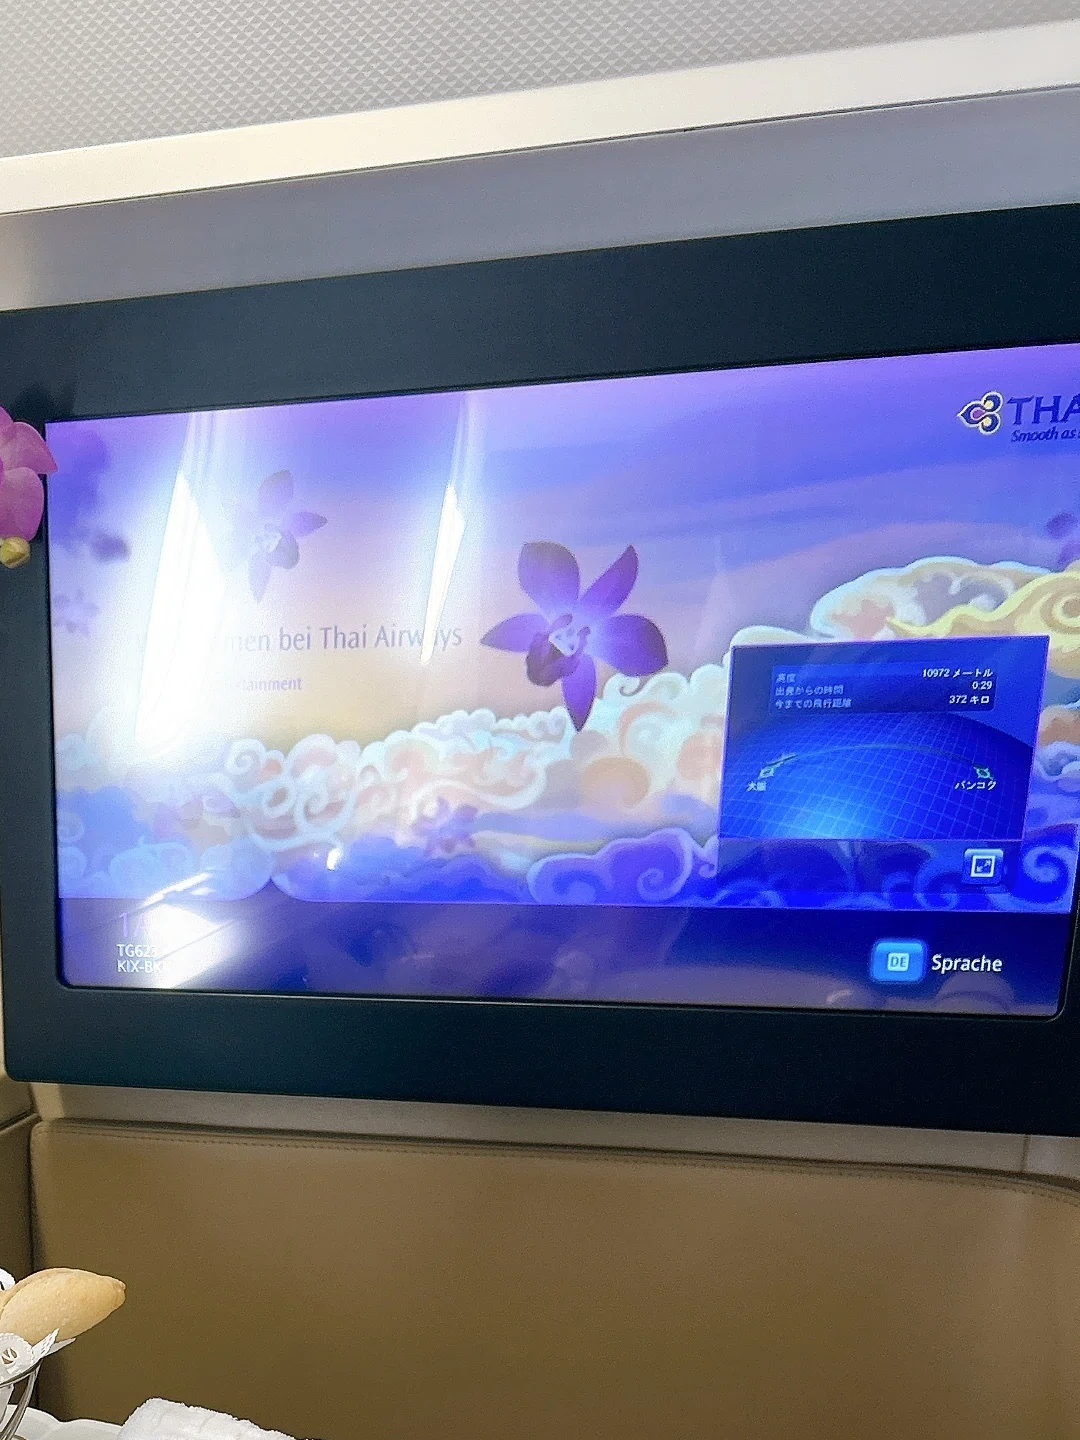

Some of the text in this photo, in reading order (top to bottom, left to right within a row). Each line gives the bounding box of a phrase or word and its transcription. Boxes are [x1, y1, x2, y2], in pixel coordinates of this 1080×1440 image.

[1011, 426, 1059, 442] Smooth
[1061, 429, 1076, 439] as
[279, 627, 312, 651] bei
[320, 625, 368, 650] Thai
[375, 624, 462, 651] Airwys
[923, 668, 994, 679] 10972 メートル
[971, 681, 993, 690] 0:29
[949, 695, 968, 704] 372
[890, 953, 1003, 975] DE Sprache
